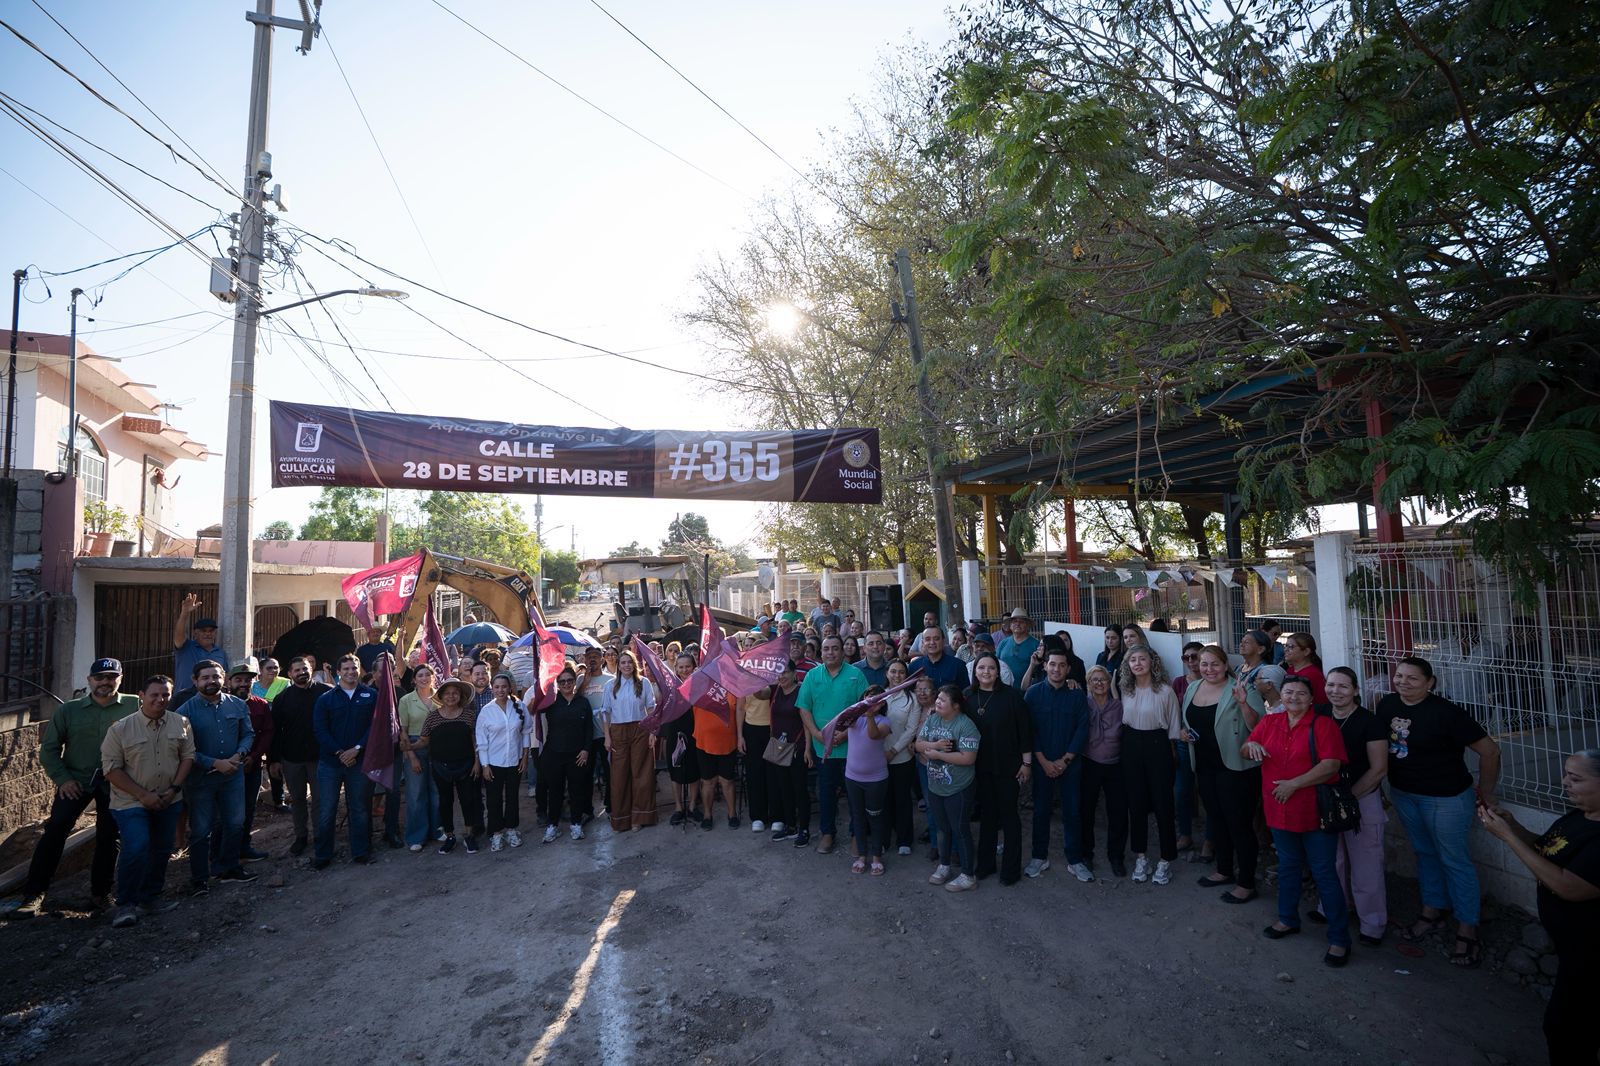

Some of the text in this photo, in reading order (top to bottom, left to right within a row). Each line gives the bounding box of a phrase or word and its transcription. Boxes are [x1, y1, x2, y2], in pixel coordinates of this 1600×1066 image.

[500, 428, 586, 442] contruye
[479, 440, 554, 459] CALLE
[280, 463, 335, 473] CULIACÁN
[668, 440, 780, 483] #355
[403, 461, 628, 487] 28 DE SEPTIEMBRE
[839, 468, 877, 479] Mundial
[843, 479, 873, 490] Social
[511, 577, 527, 594] CAT
